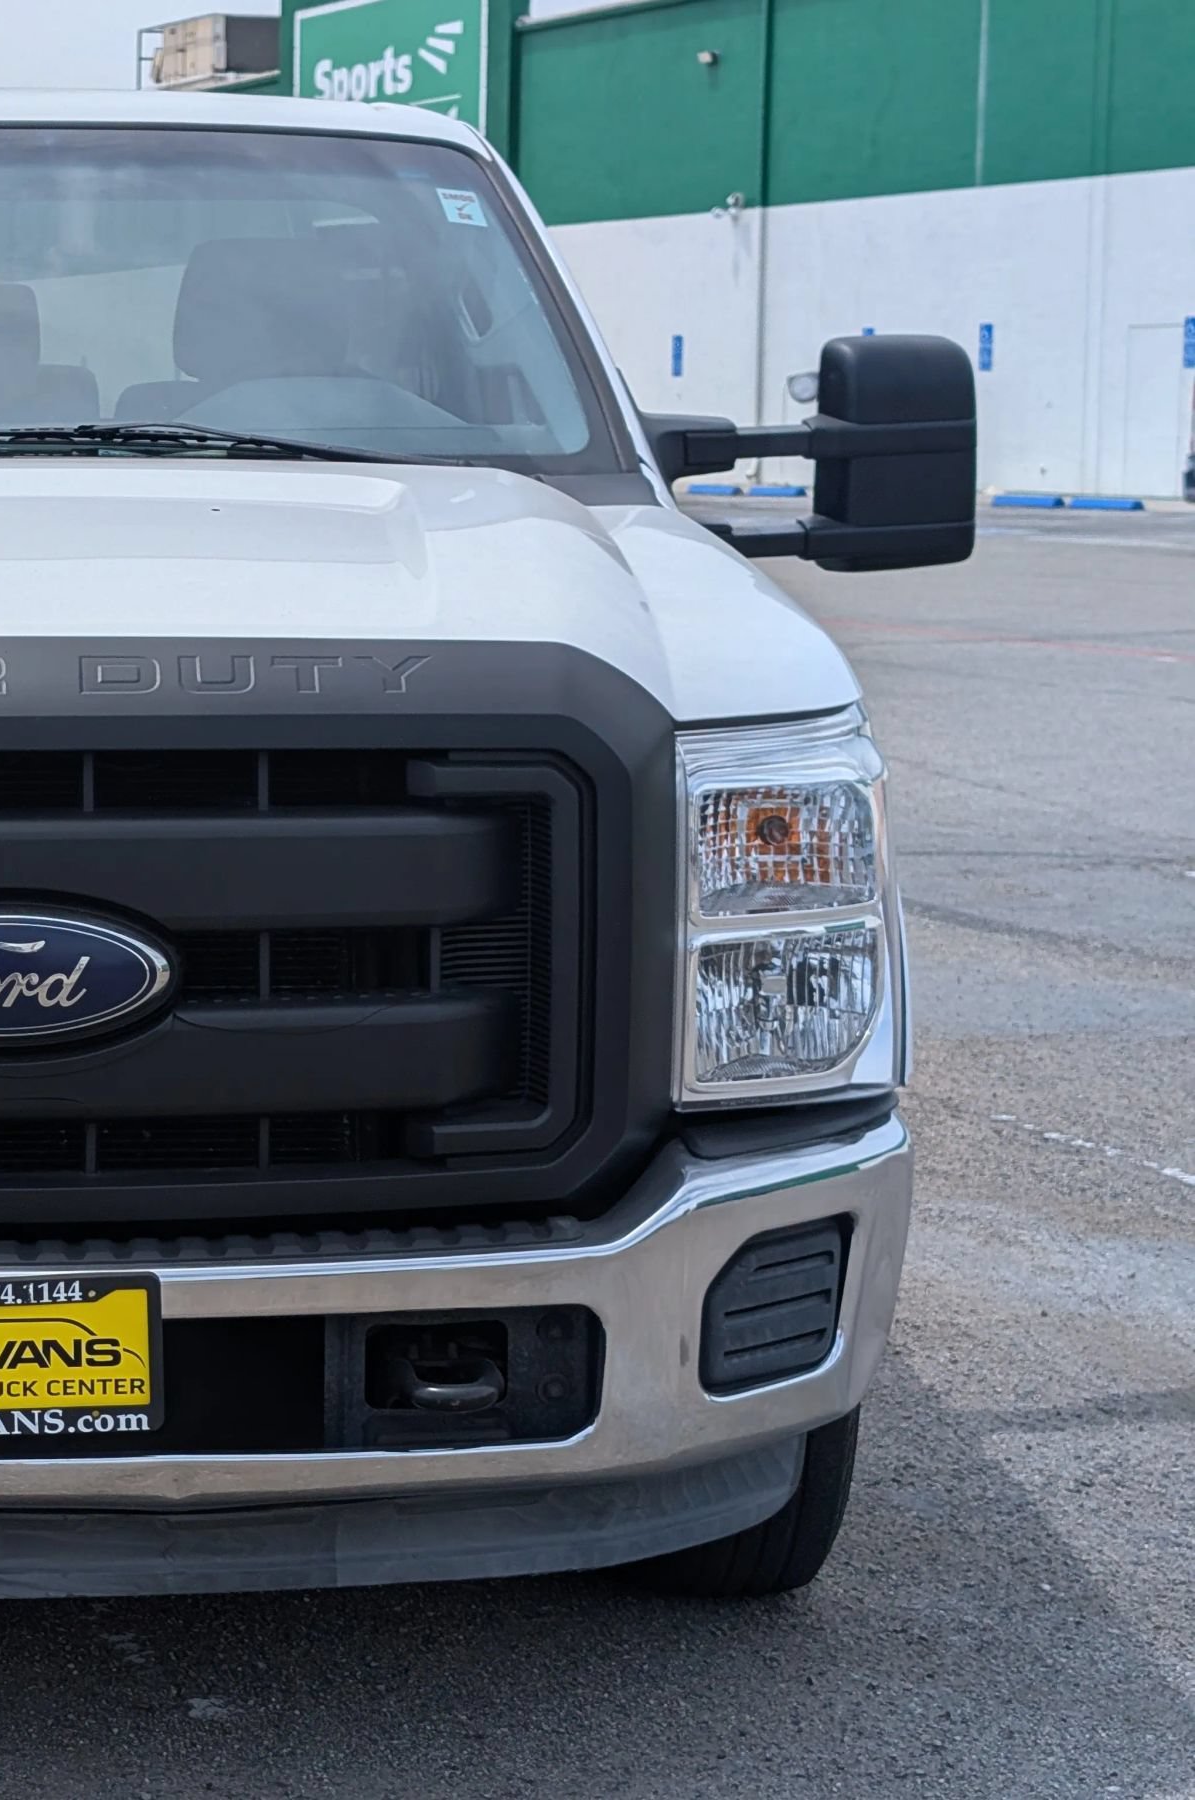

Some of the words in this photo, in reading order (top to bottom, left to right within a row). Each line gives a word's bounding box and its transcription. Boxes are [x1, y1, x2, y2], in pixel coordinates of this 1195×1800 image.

[314, 46, 412, 101] Sports
[78, 655, 433, 695] DUTY
[46, 1378, 146, 1396] CENTER
